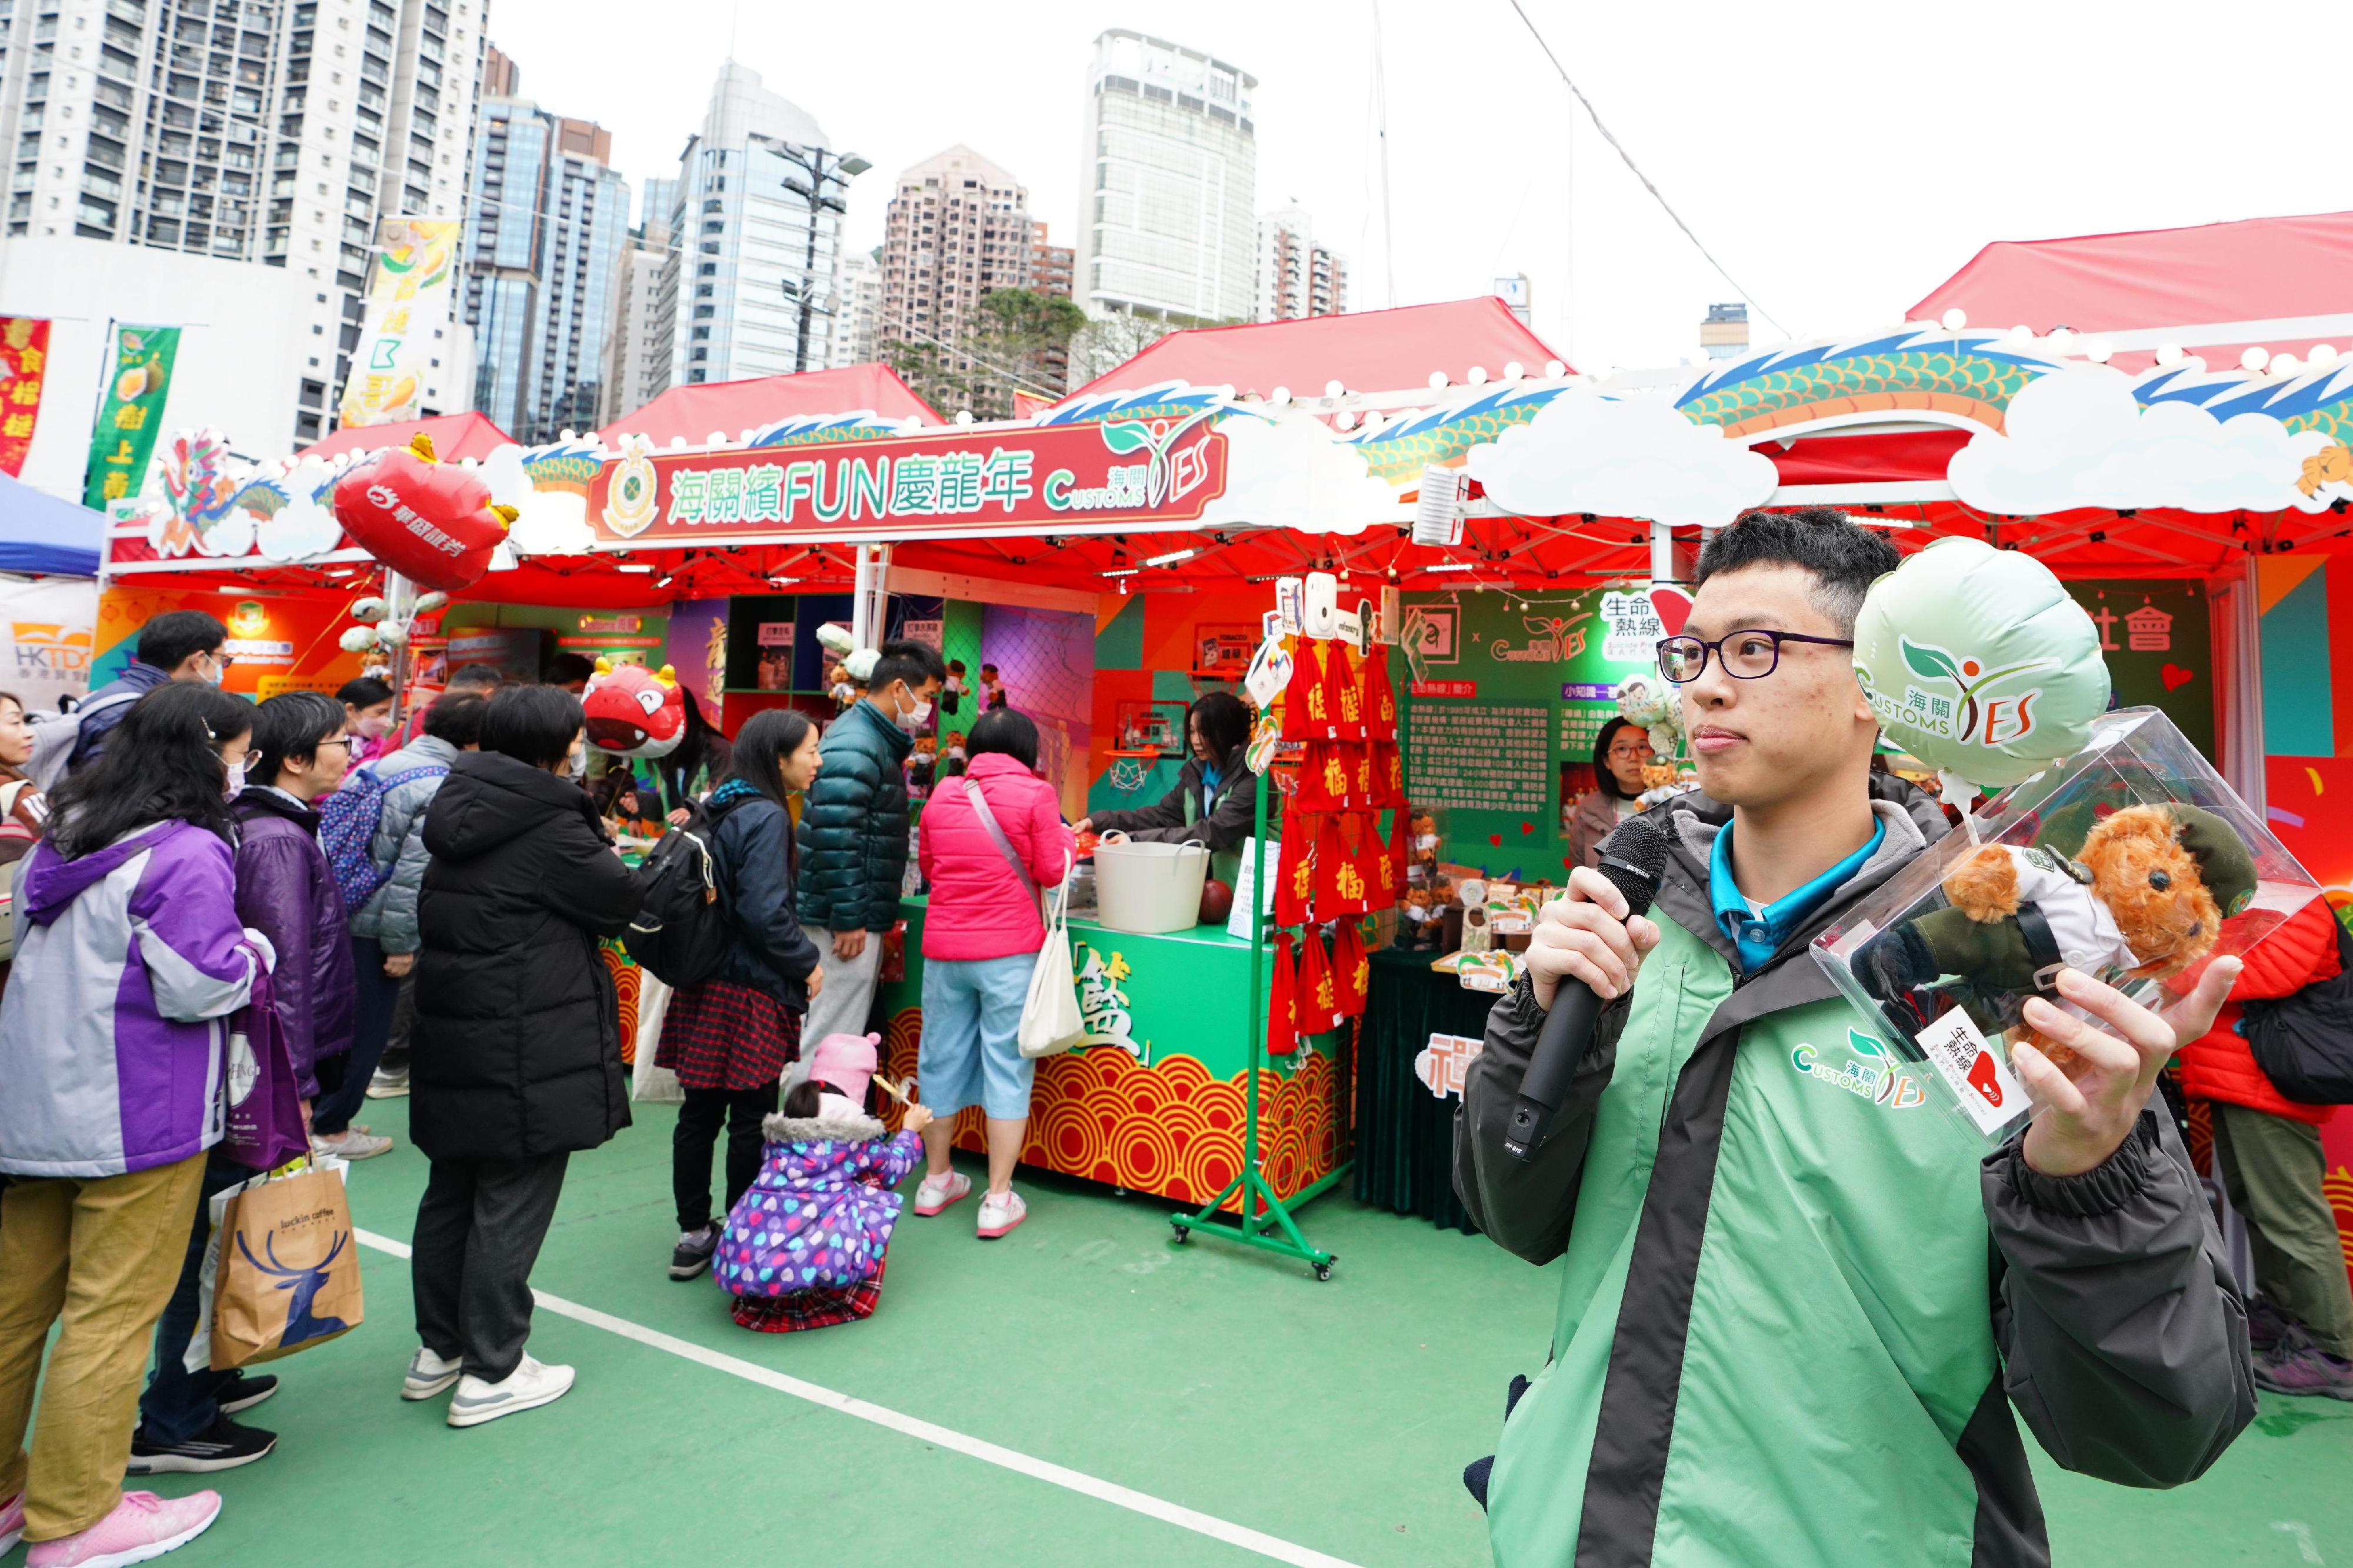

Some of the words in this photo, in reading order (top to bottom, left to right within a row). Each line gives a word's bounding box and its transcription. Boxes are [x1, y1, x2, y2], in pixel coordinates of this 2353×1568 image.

[668, 447, 1034, 524] 海關繽FUN慶龍年
[1107, 465, 1146, 488] 海關
[1607, 598, 1649, 616] 生命
[1616, 618, 1660, 636] 熱線
[1854, 665, 1949, 735] CUSTOMS
[1908, 689, 1950, 719] 海關
[1324, 758, 1347, 796] 福
[1336, 861, 1364, 900] 福
[1944, 1039, 1972, 1073] 熱線
[1951, 1027, 1978, 1057] 生命
[1792, 1043, 1874, 1099] CUSTOMS
[1846, 1059, 1877, 1085] 海關
